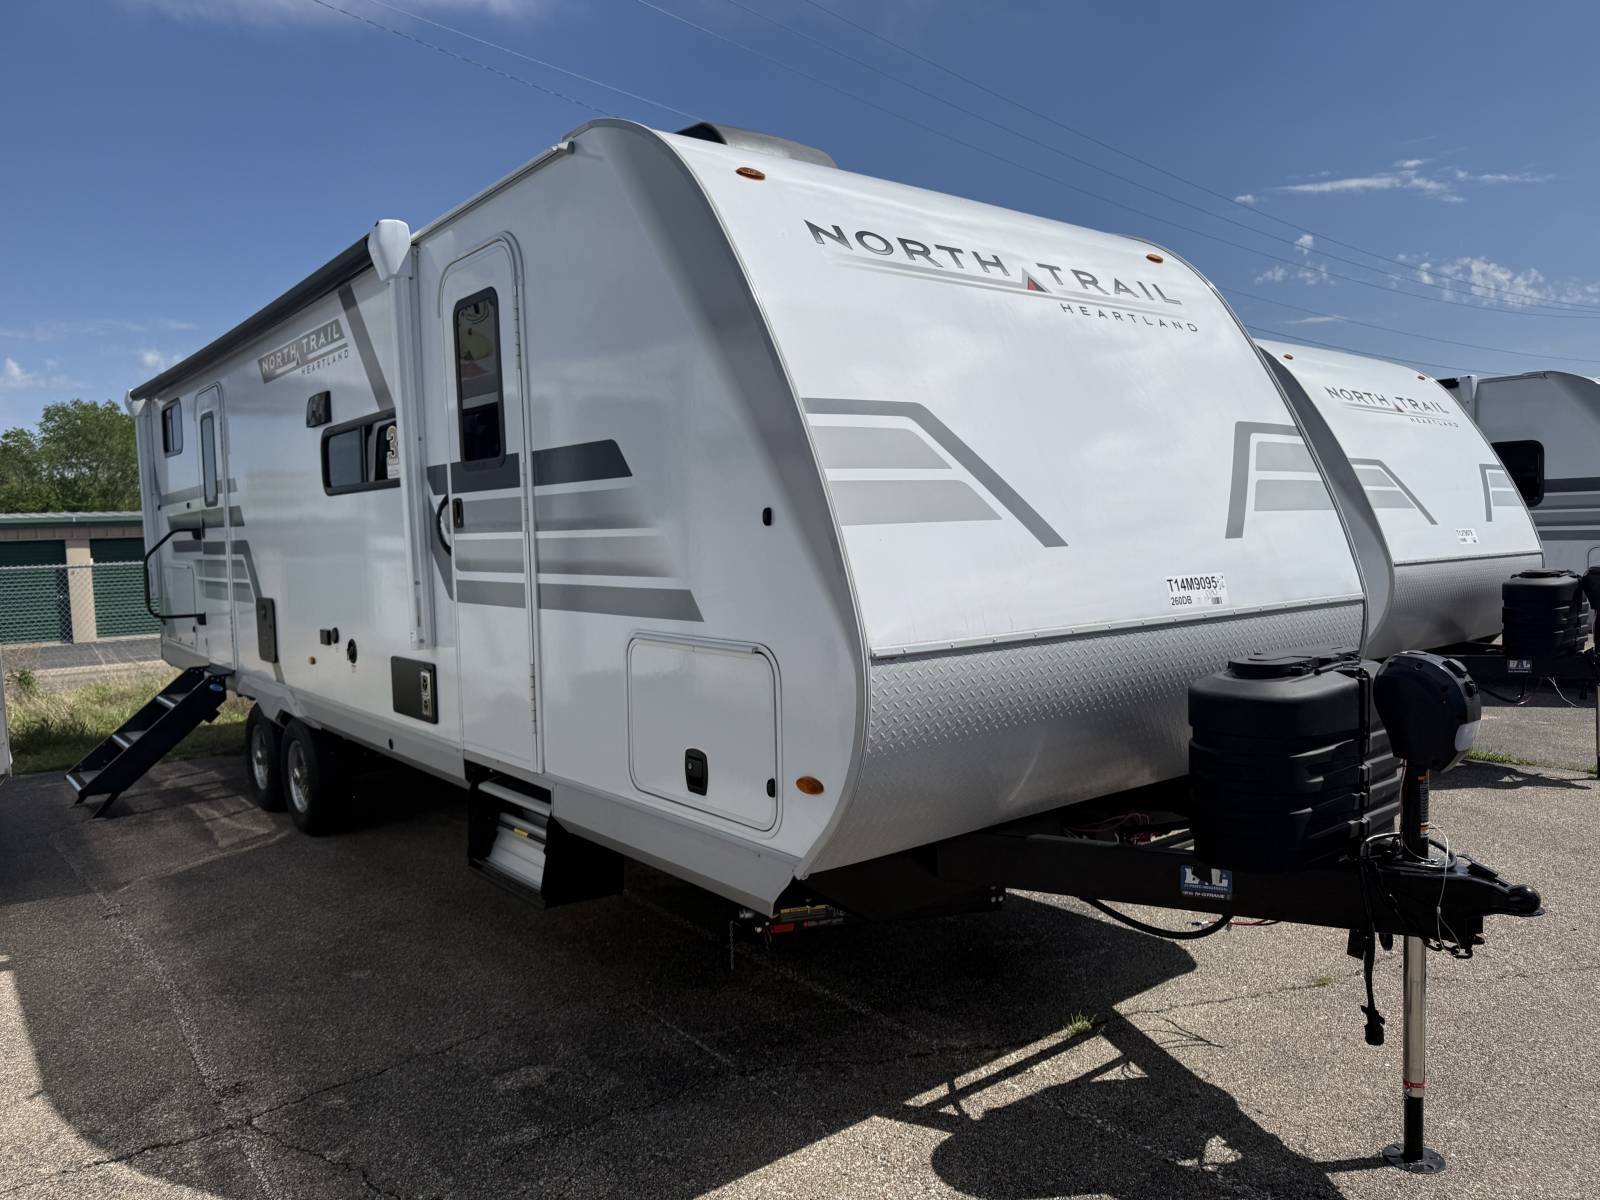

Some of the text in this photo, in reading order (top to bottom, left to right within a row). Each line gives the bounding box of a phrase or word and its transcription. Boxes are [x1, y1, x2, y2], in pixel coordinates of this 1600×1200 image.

[803, 218, 1183, 305] NORTH TRAIL
[1060, 302, 1199, 332] HEARTLAND
[262, 323, 340, 374] NORTH TRAIL
[301, 348, 350, 376] HEARTLAND
[1324, 386, 1450, 414] NORTH TRAIL
[1410, 418, 1459, 428] HEARTLAND
[1170, 595, 1193, 606] 260DB
